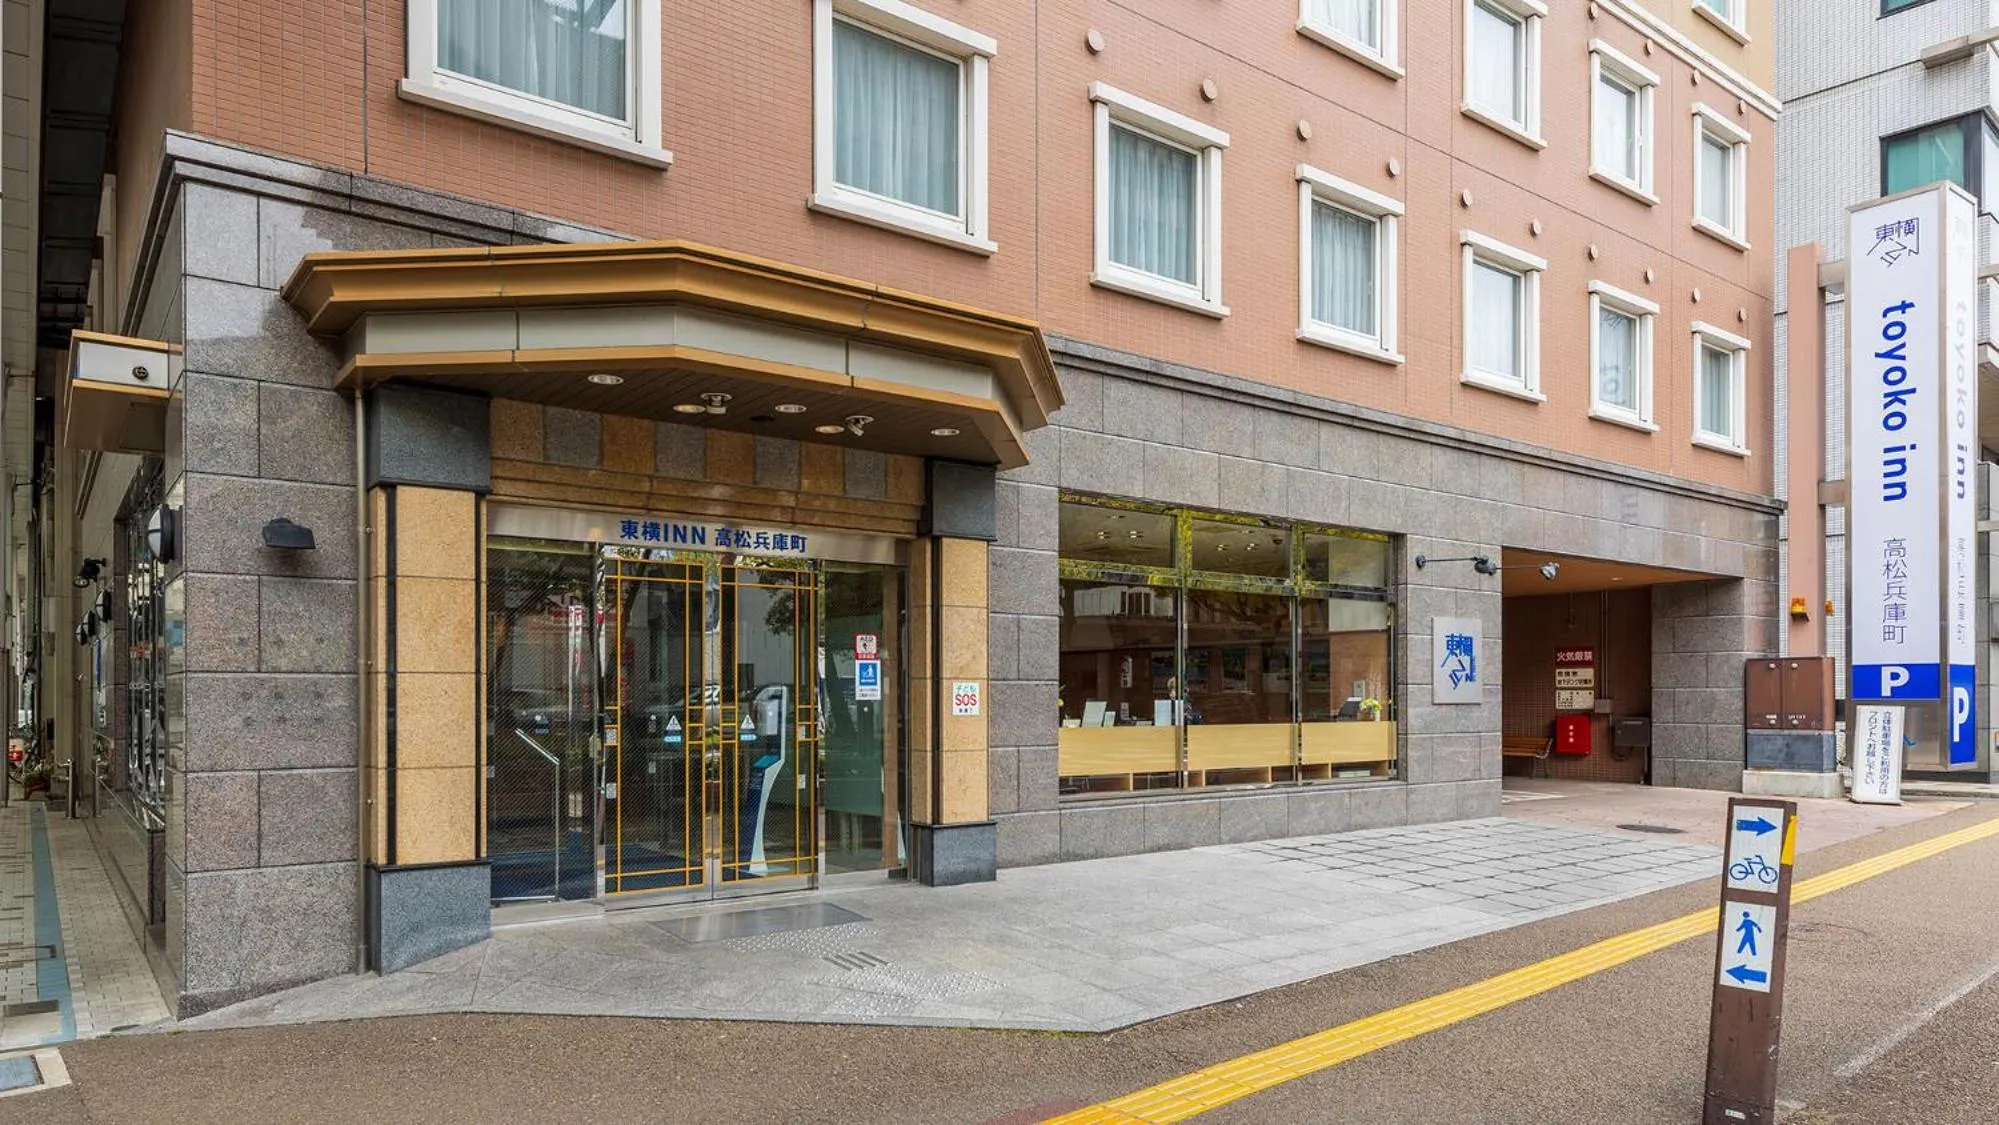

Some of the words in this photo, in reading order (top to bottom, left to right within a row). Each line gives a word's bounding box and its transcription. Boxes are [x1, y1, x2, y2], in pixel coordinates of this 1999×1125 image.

[1874, 300, 1916, 431] toyoko
[1883, 443, 1917, 502] inn
[1957, 444, 1968, 499] inn
[620, 519, 706, 545] 東横INN
[714, 527, 808, 553] 高松兵庫町
[1883, 537, 1908, 645] 高松兵庫町
[955, 693, 977, 706] SOS
[1881, 666, 1910, 697] P
[1953, 687, 1970, 742] P
